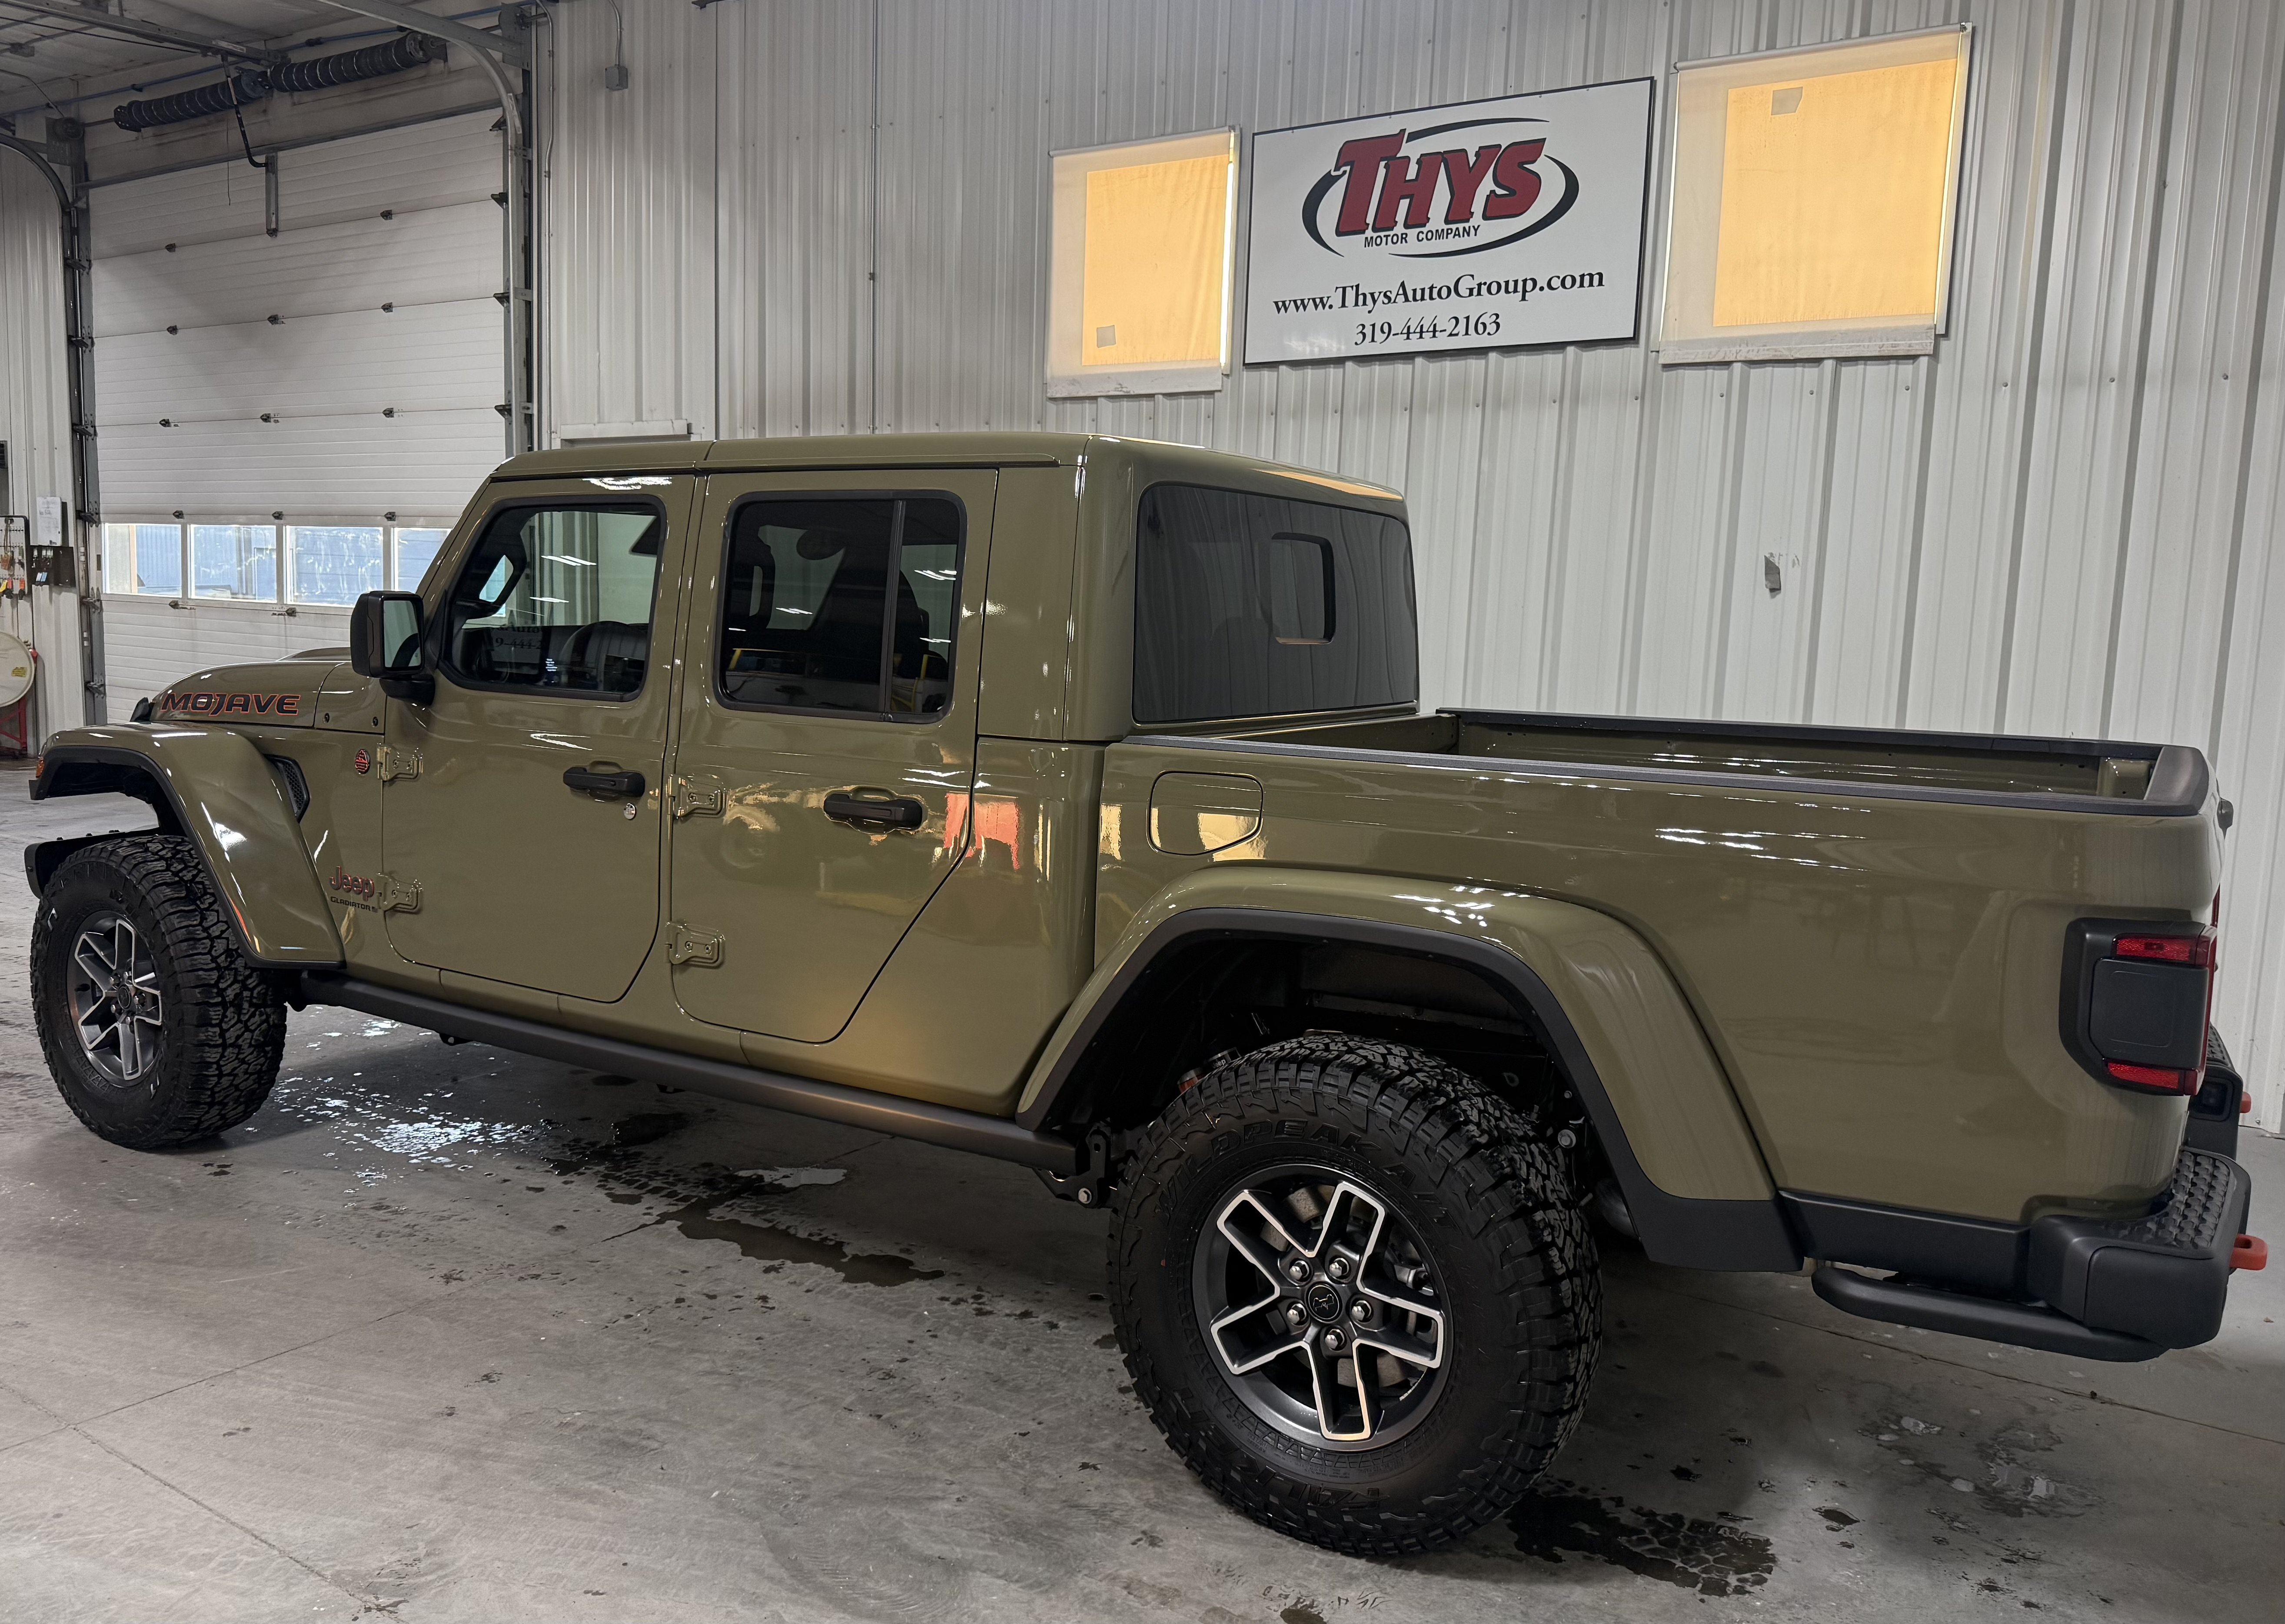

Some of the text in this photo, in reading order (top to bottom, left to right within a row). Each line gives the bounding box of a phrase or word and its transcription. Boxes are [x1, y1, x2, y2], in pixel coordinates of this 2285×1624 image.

[1334, 129, 1547, 237] THYS
[1364, 224, 1481, 248] MOTOR COMPANY
[1273, 271, 1605, 315] www.ThysAutoGroup.com
[1354, 312, 1501, 346] 319-444-2163
[160, 693, 301, 716] MOJAVE
[329, 866, 375, 901] Jeep
[330, 897, 371, 911] GLADIATOR
[1154, 1119, 1381, 1225] WILDPEAK
